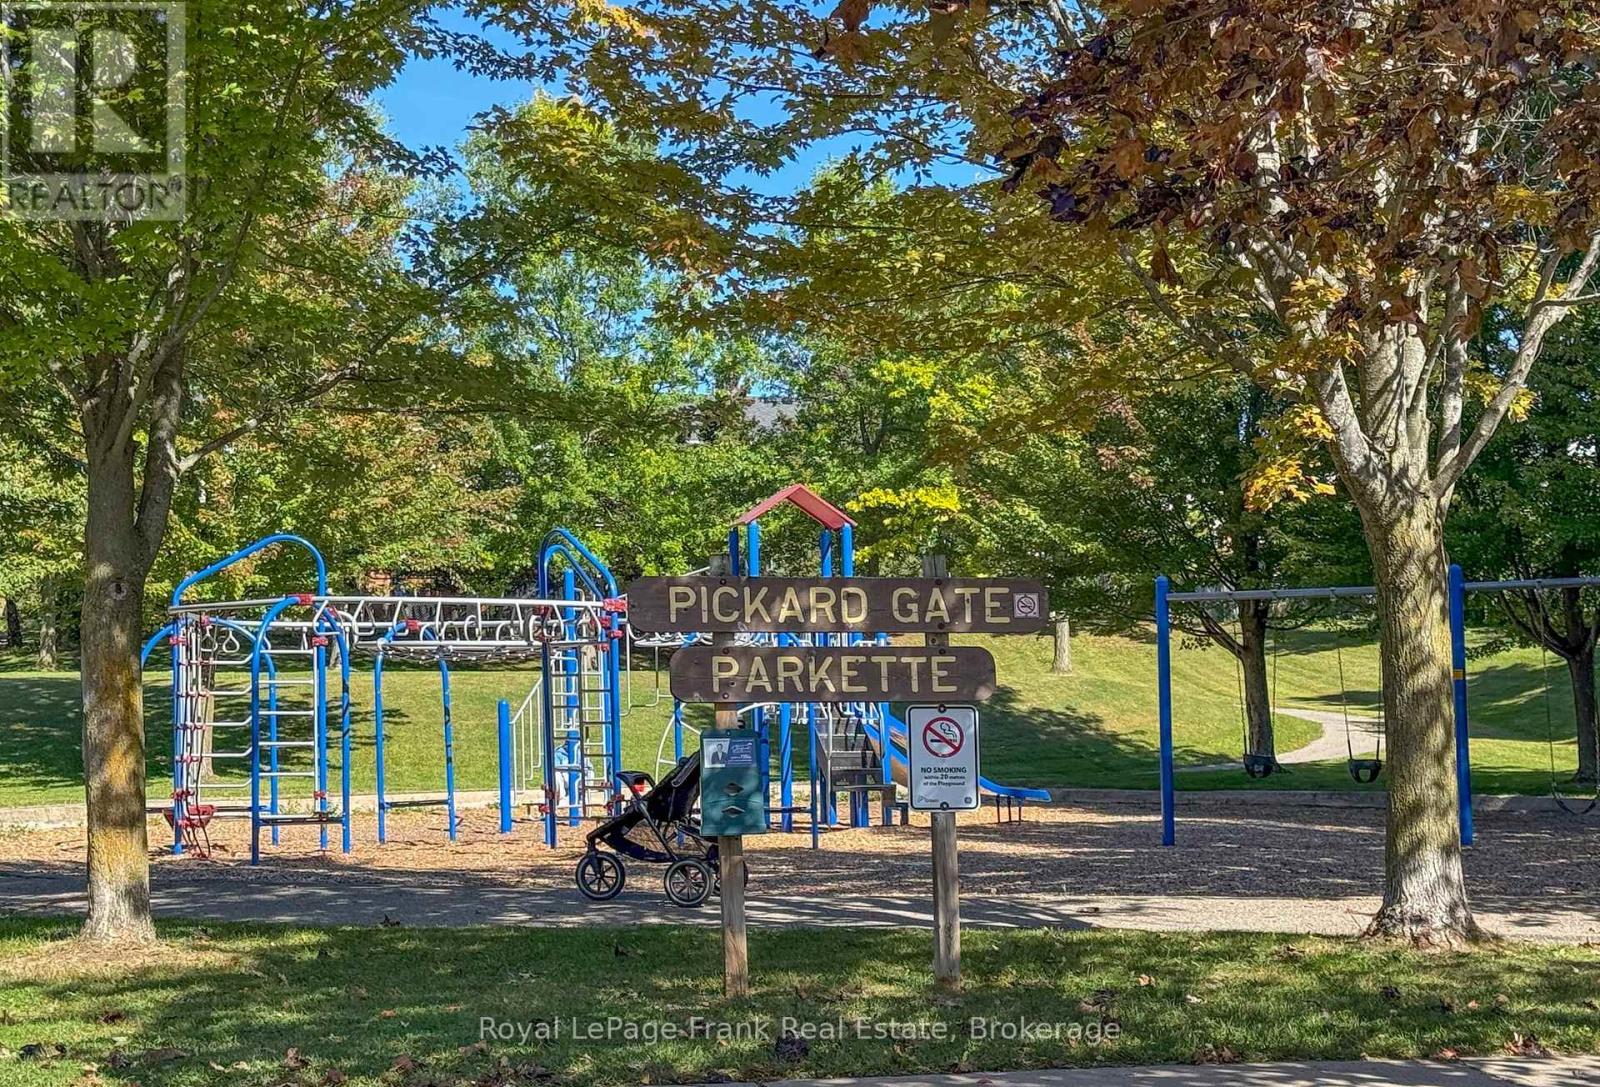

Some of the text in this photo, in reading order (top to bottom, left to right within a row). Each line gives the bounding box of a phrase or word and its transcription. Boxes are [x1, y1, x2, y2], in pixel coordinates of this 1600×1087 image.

[669, 586, 1010, 624] PICKARD GATE
[711, 656, 958, 693] PARKETTE
